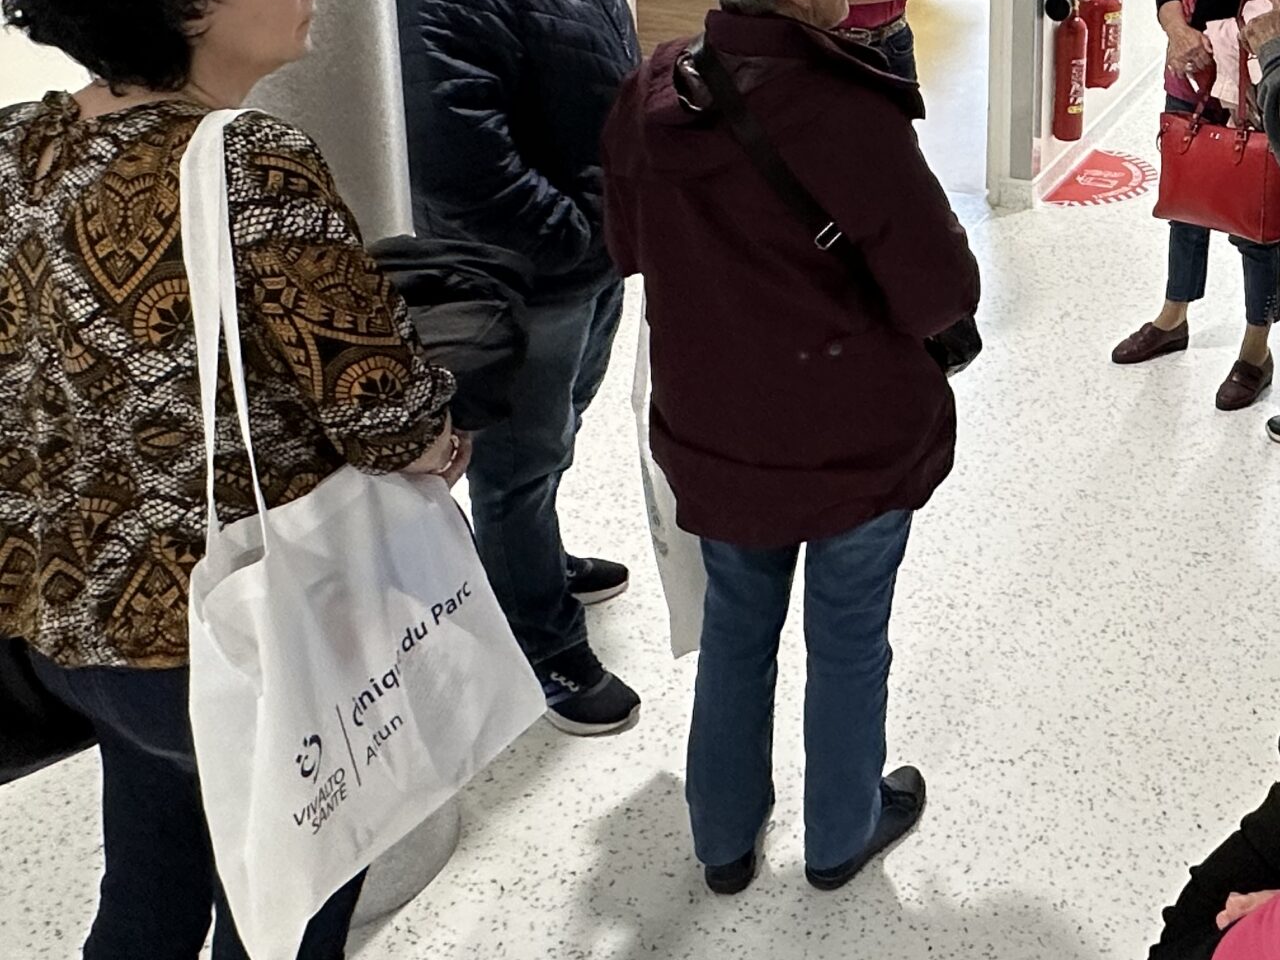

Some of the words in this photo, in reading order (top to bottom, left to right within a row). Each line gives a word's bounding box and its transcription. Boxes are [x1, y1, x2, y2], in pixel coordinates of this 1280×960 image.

[402, 621, 429, 652] du
[430, 581, 472, 625] Parc
[366, 715, 404, 766] Atun
[293, 767, 346, 826] VIVALTO
